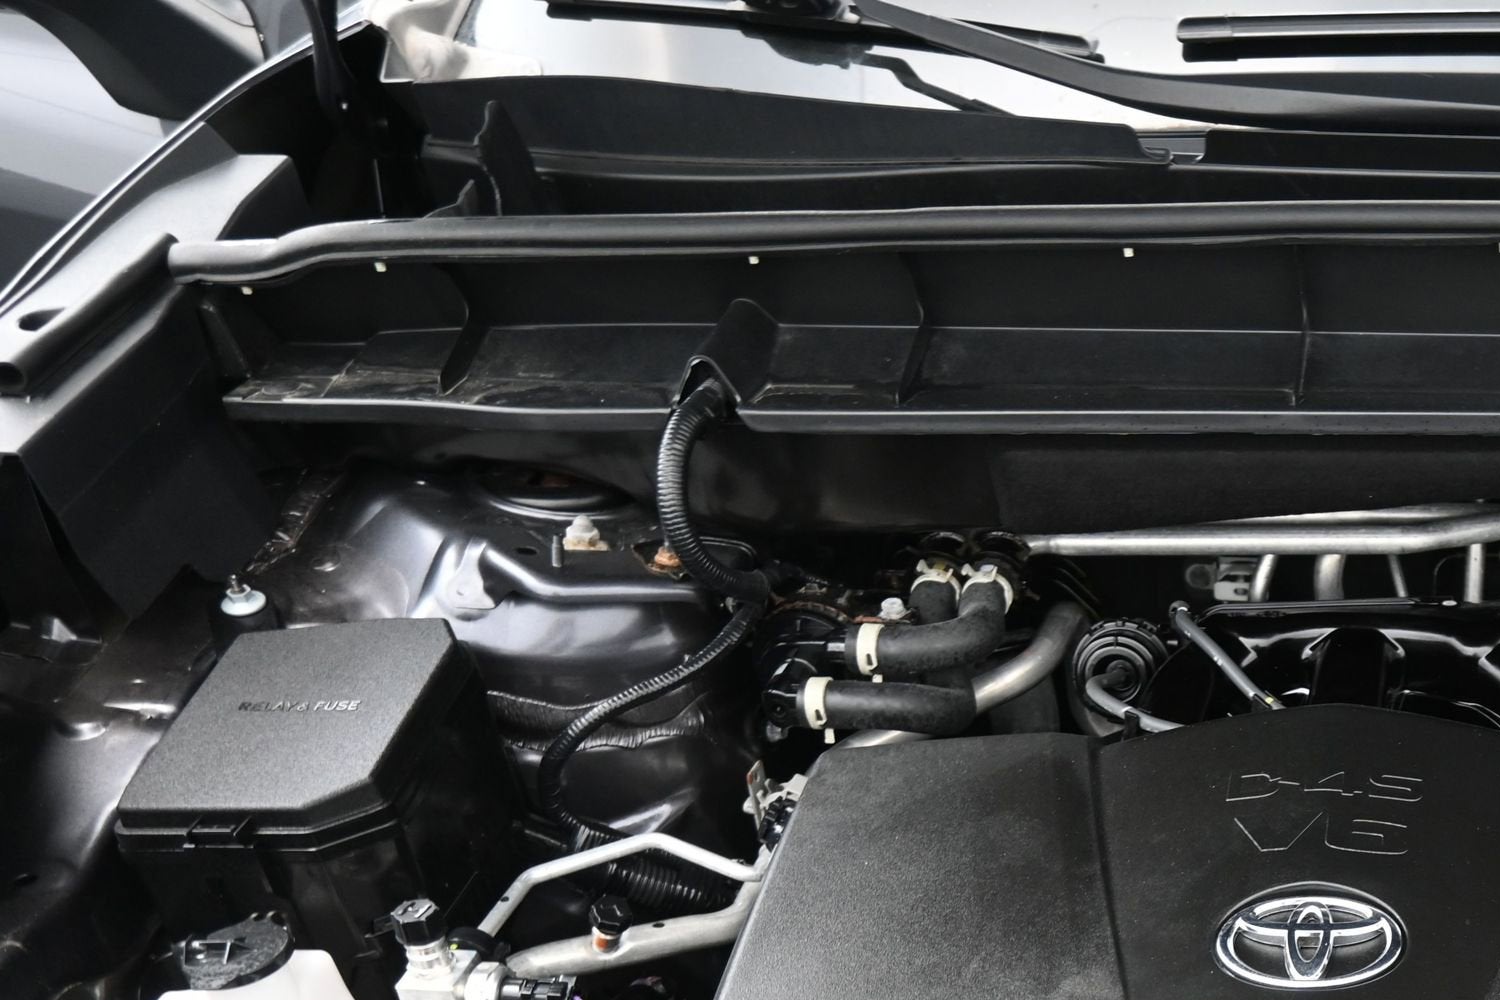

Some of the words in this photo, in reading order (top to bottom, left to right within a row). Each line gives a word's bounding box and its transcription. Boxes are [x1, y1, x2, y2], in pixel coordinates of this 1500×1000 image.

[238, 701, 298, 712] RELAY
[297, 701, 310, 712] &
[313, 699, 361, 712] FUSE
[1234, 808, 1409, 856] V6
